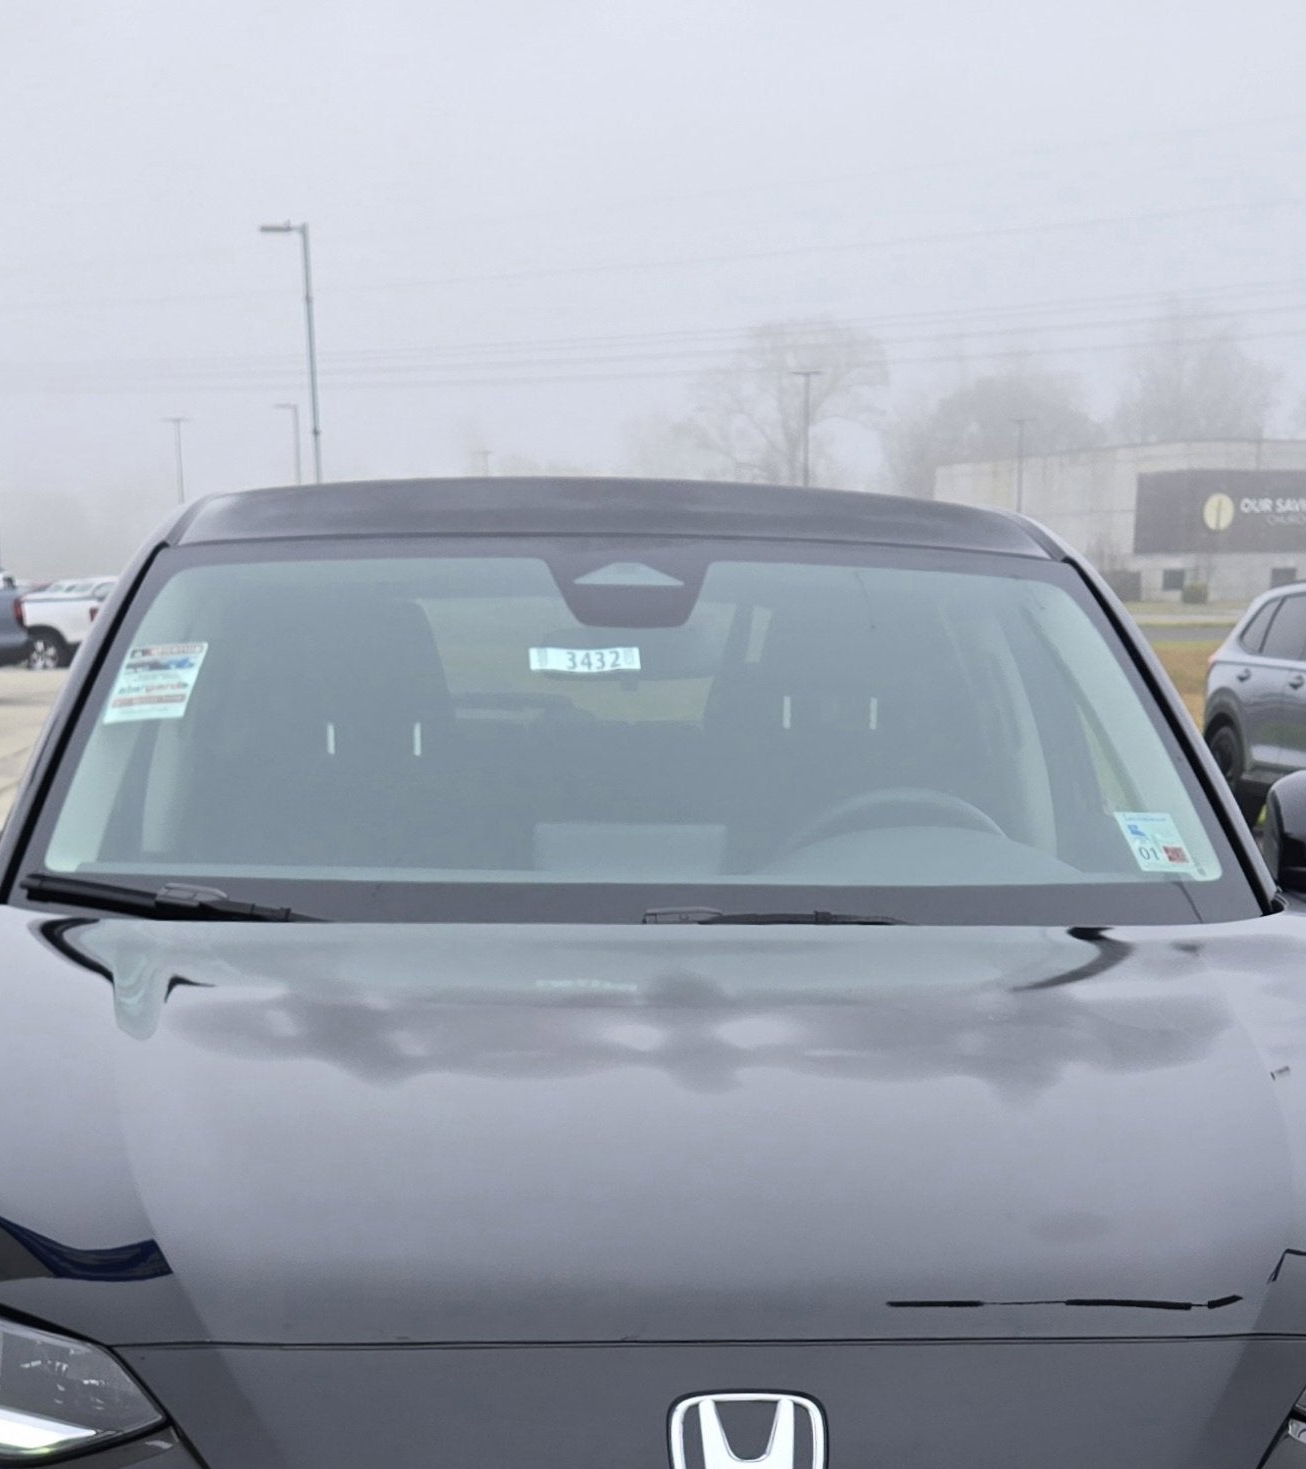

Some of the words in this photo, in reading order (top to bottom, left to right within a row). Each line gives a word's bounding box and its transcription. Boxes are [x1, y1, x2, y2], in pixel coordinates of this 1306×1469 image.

[1240, 498, 1272, 513] OUR
[565, 650, 622, 671] 3432
[1138, 846, 1160, 861] 01
